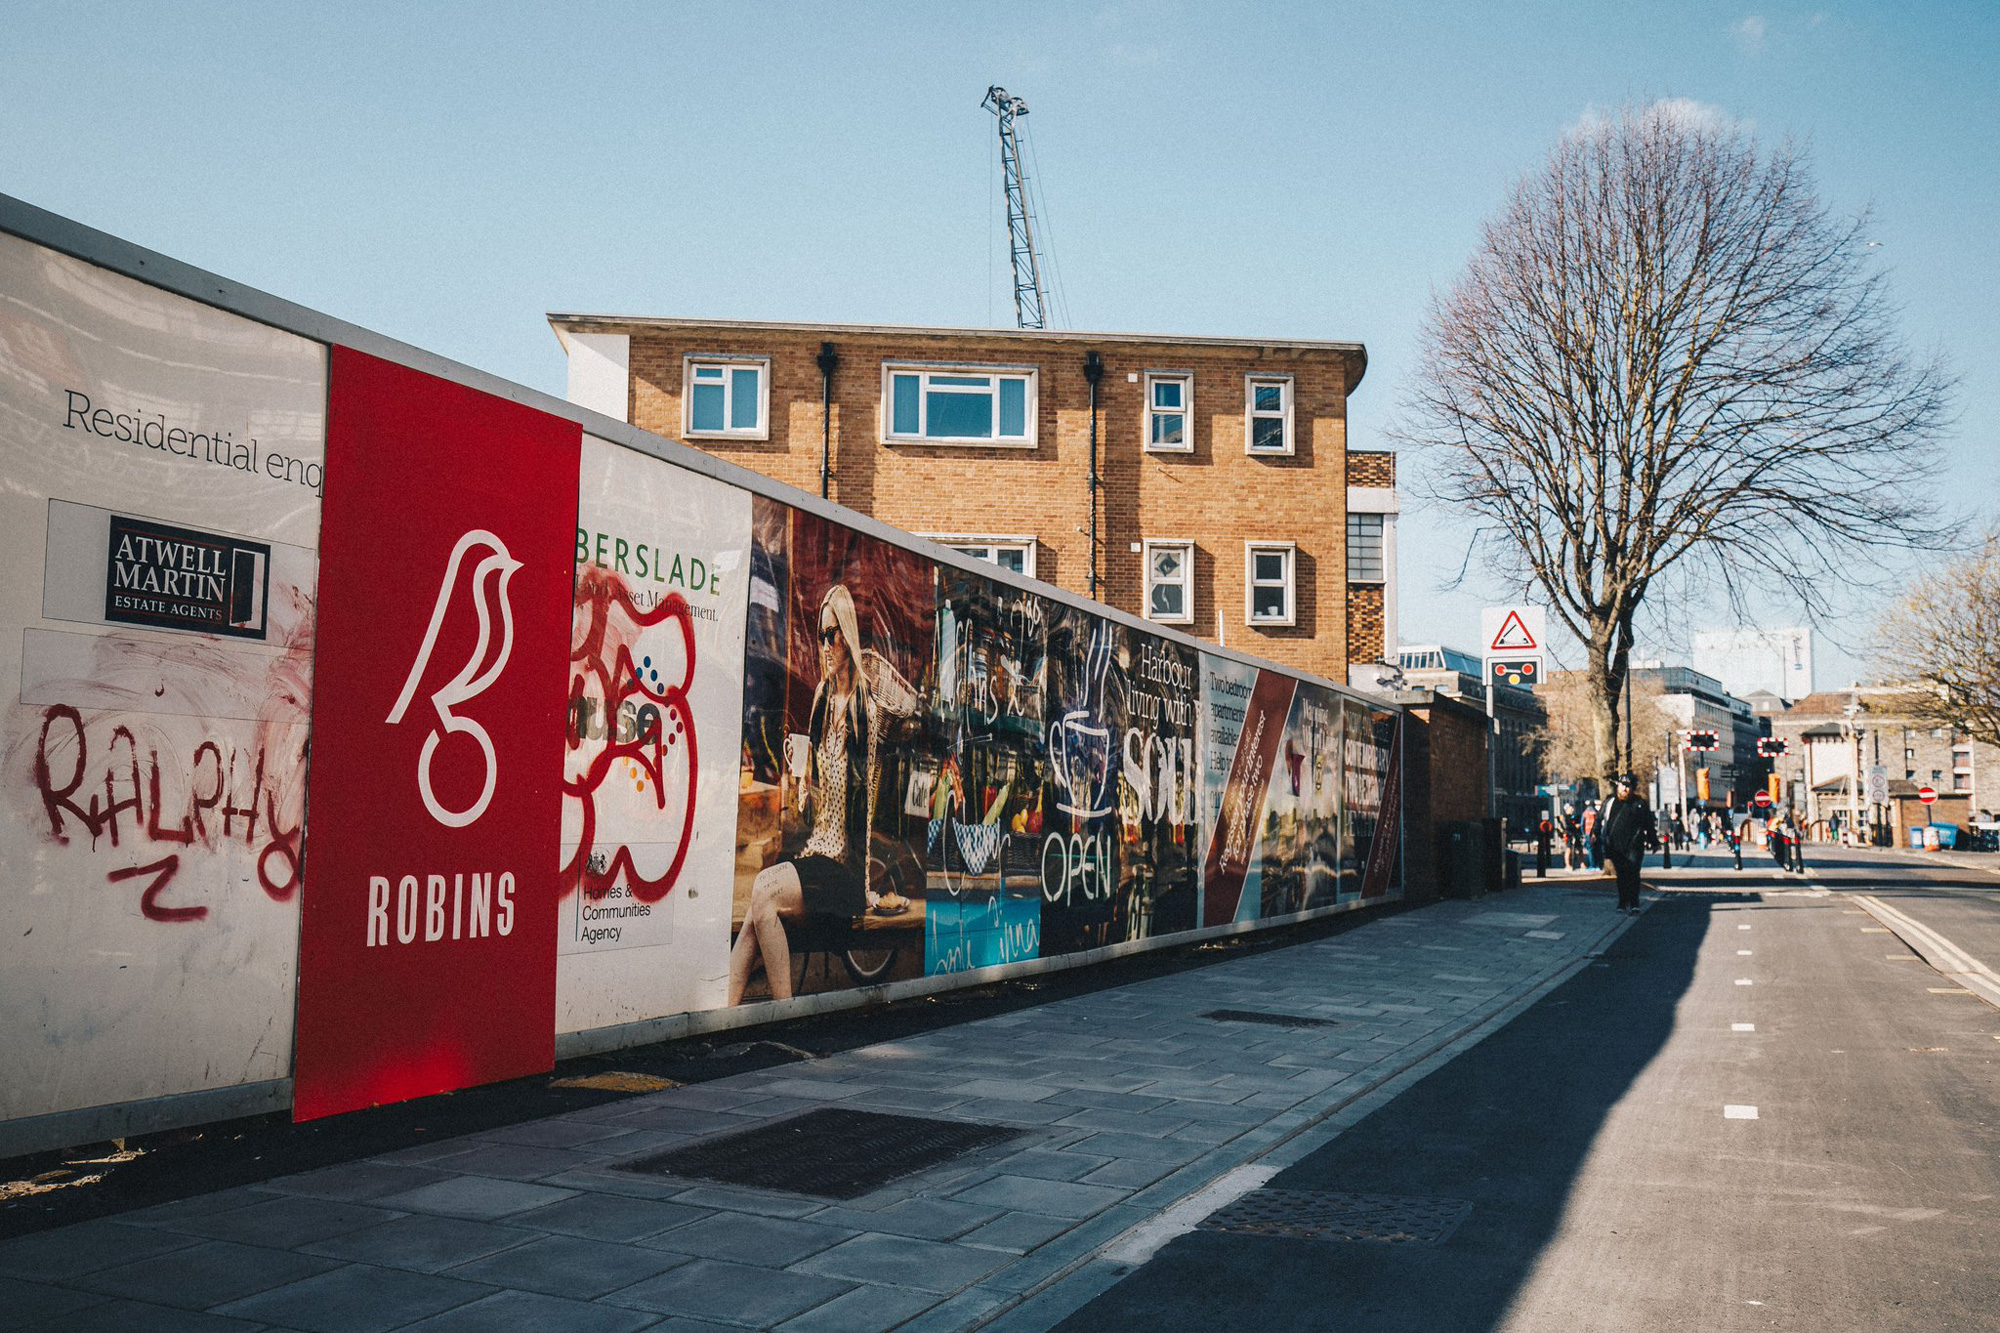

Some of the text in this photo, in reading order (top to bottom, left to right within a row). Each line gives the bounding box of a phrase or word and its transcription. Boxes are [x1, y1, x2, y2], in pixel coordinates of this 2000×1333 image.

[63, 389, 323, 499] Residential enq
[115, 534, 226, 576] ATWELL
[577, 527, 720, 597] BERSLADE
[114, 561, 225, 603] MARTIN
[115, 595, 222, 621] ESTATE AGENTS
[1141, 643, 1193, 690] Harbour
[1210, 671, 1225, 694] Two
[1128, 679, 1193, 730] living with
[1245, 709, 1266, 771] interest
[1123, 727, 1200, 827] SOUL
[1210, 751, 1226, 776] Help
[624, 882, 633, 898] &
[1041, 831, 1111, 907] OPEN
[366, 871, 516, 948] ROBINS
[582, 903, 651, 921] Communities
[580, 926, 622, 945] Agency
